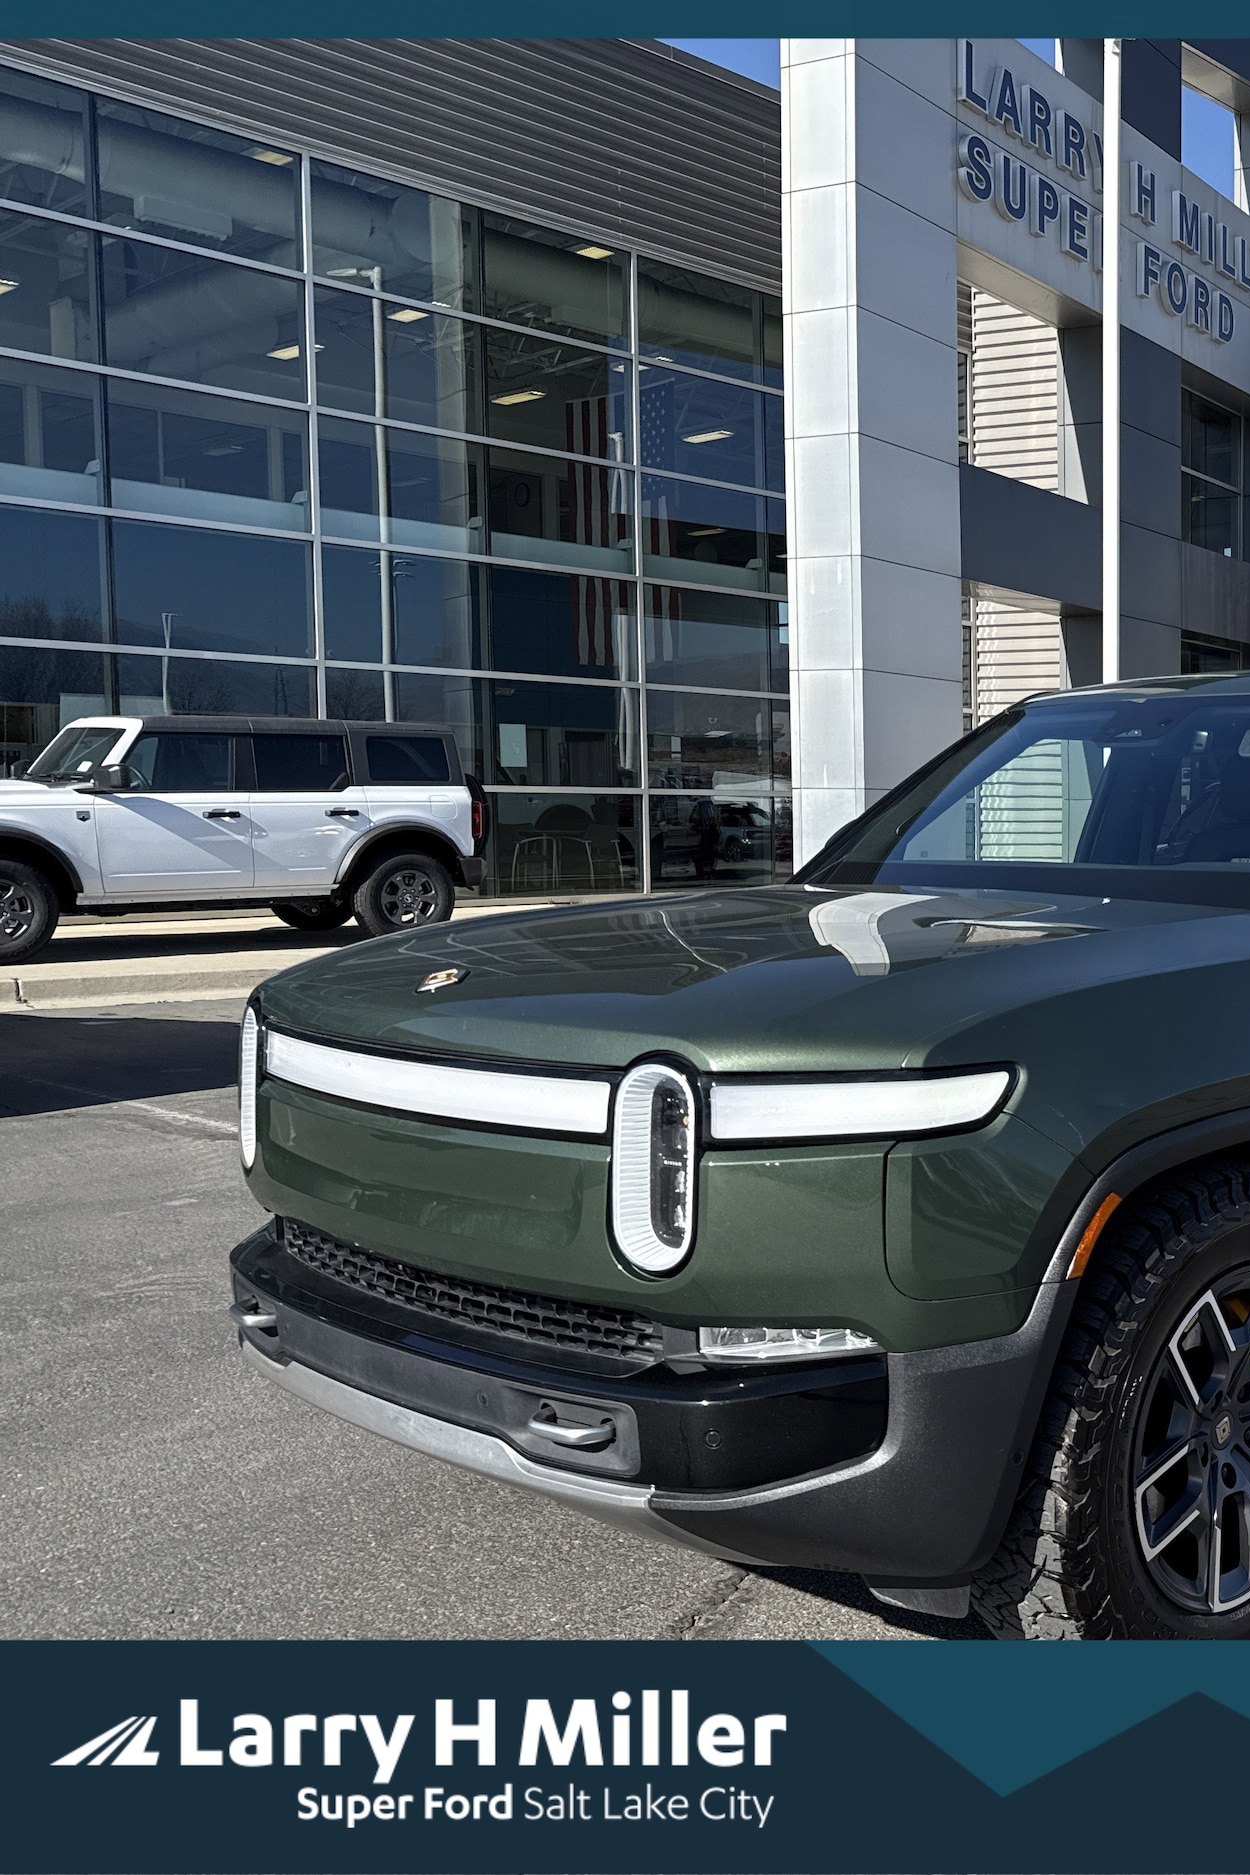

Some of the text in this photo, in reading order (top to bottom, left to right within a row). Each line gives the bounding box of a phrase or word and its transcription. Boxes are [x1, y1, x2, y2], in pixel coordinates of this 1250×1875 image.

[958, 133, 1236, 345] SUPE FORD
[1130, 160, 1157, 226] H
